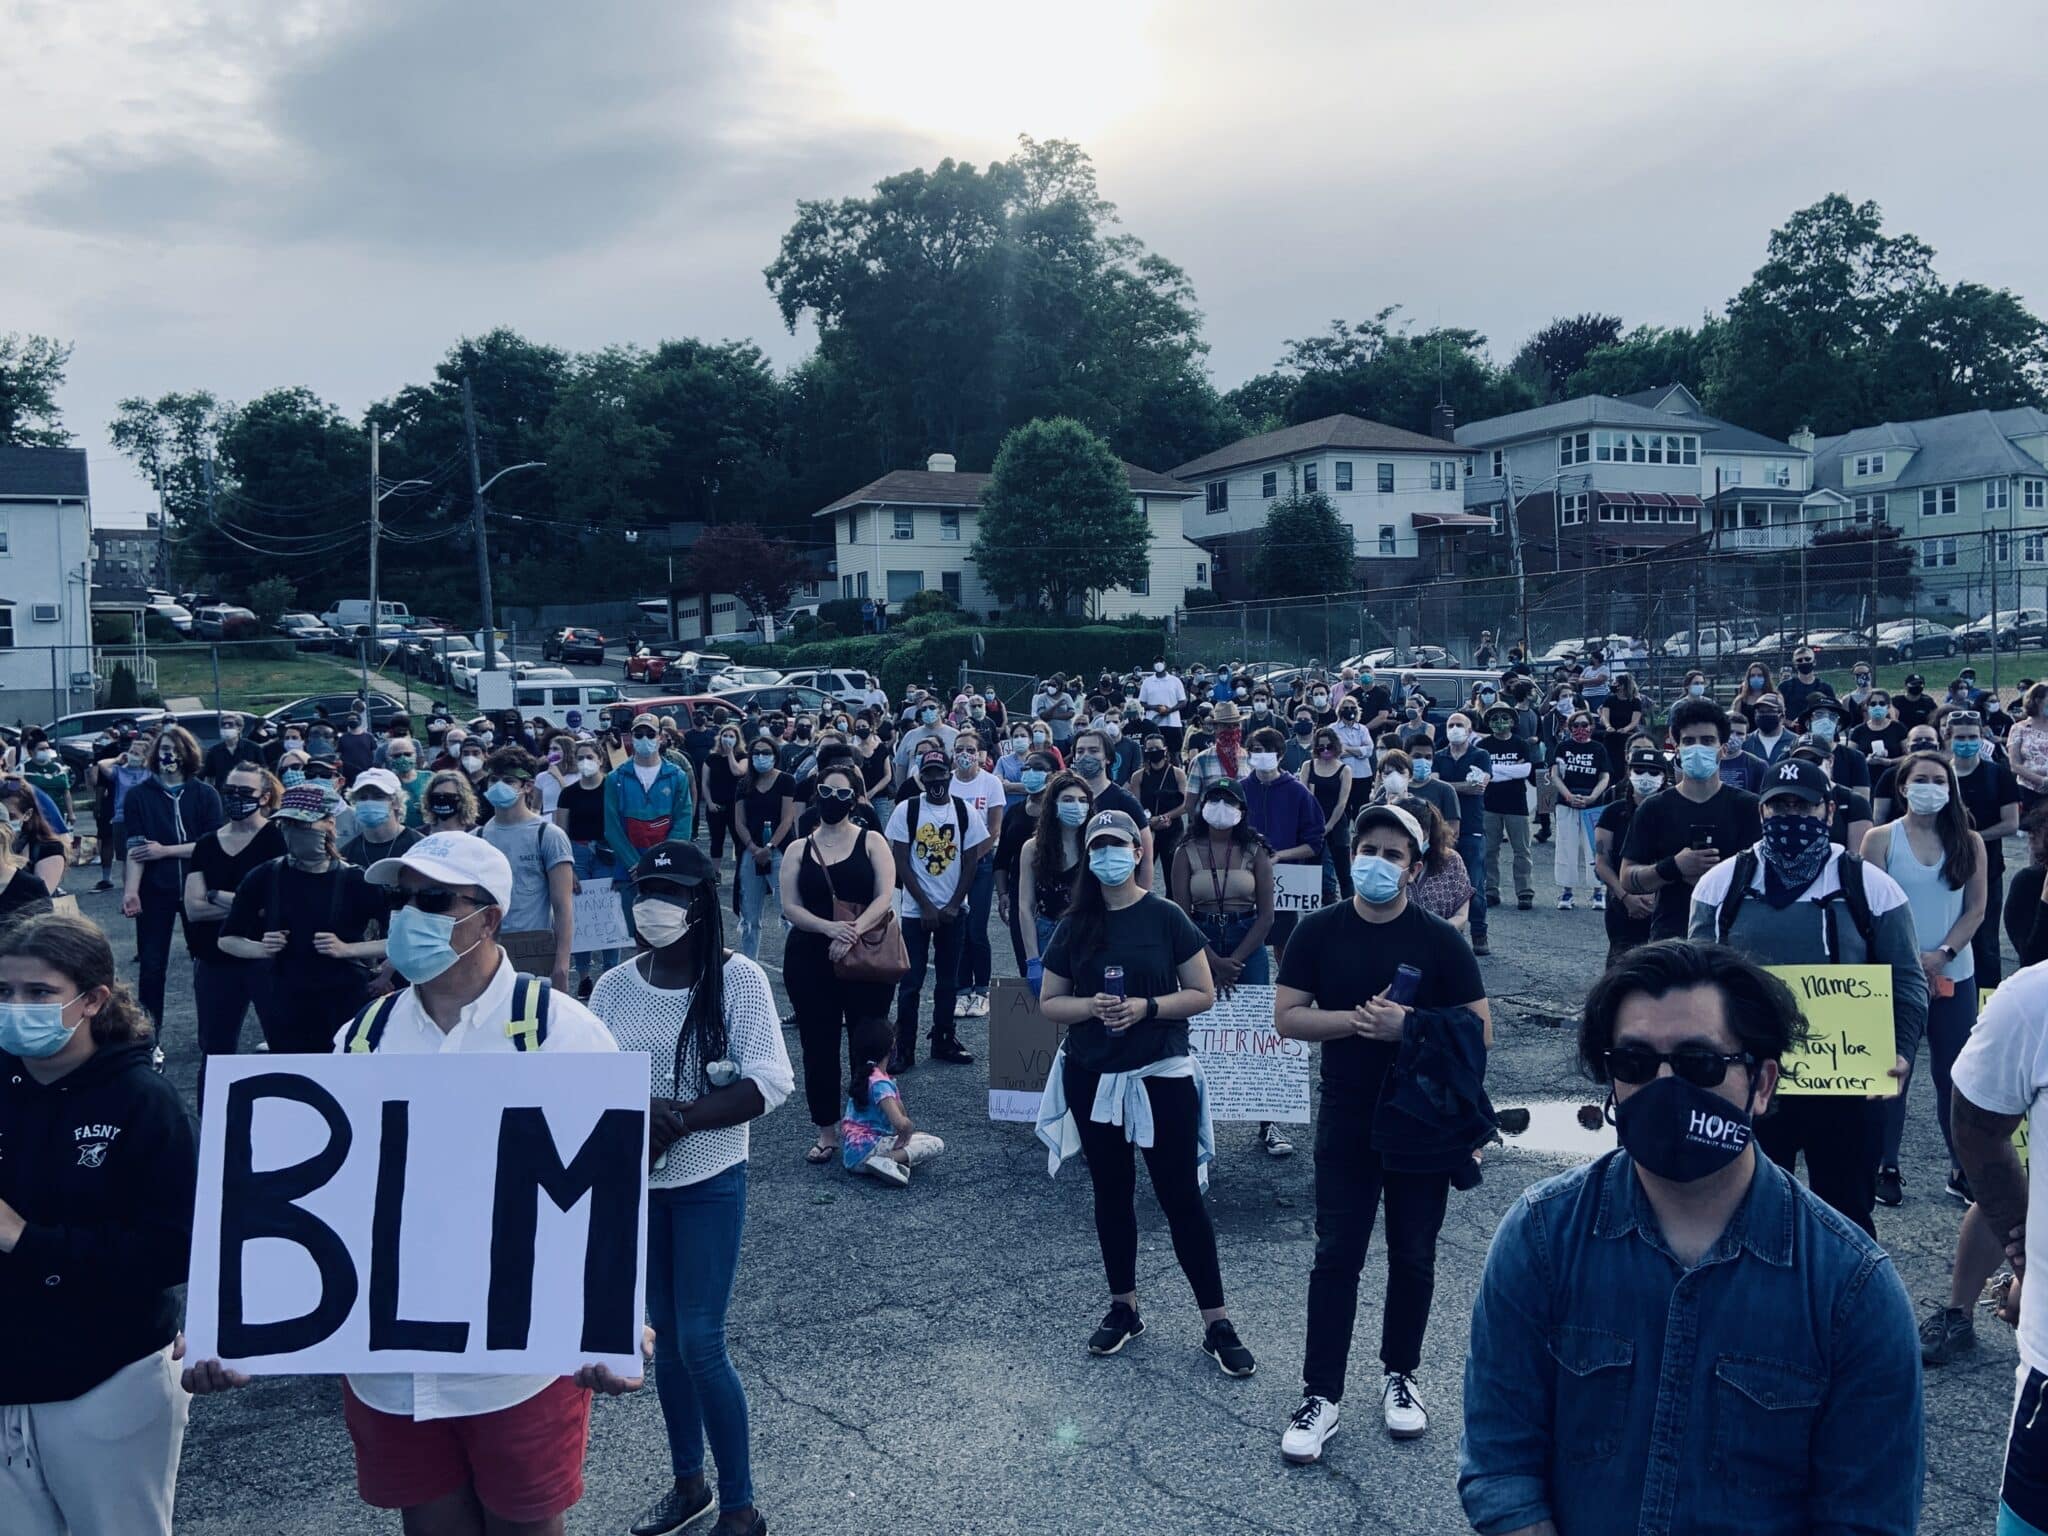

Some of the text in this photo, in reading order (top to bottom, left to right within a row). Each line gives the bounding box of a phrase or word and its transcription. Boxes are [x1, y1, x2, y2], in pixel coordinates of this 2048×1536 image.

[1490, 752, 1518, 760] BLACK
[574, 896, 615, 912] HANGE
[1275, 893, 1320, 910] ATTER
[574, 921, 617, 938] ACED
[1200, 1029, 1303, 1056] THEIR NAMES
[74, 1124, 122, 1140] FASNY
[1689, 1109, 1751, 1144] HOPE
[217, 1072, 645, 1358] BLM
